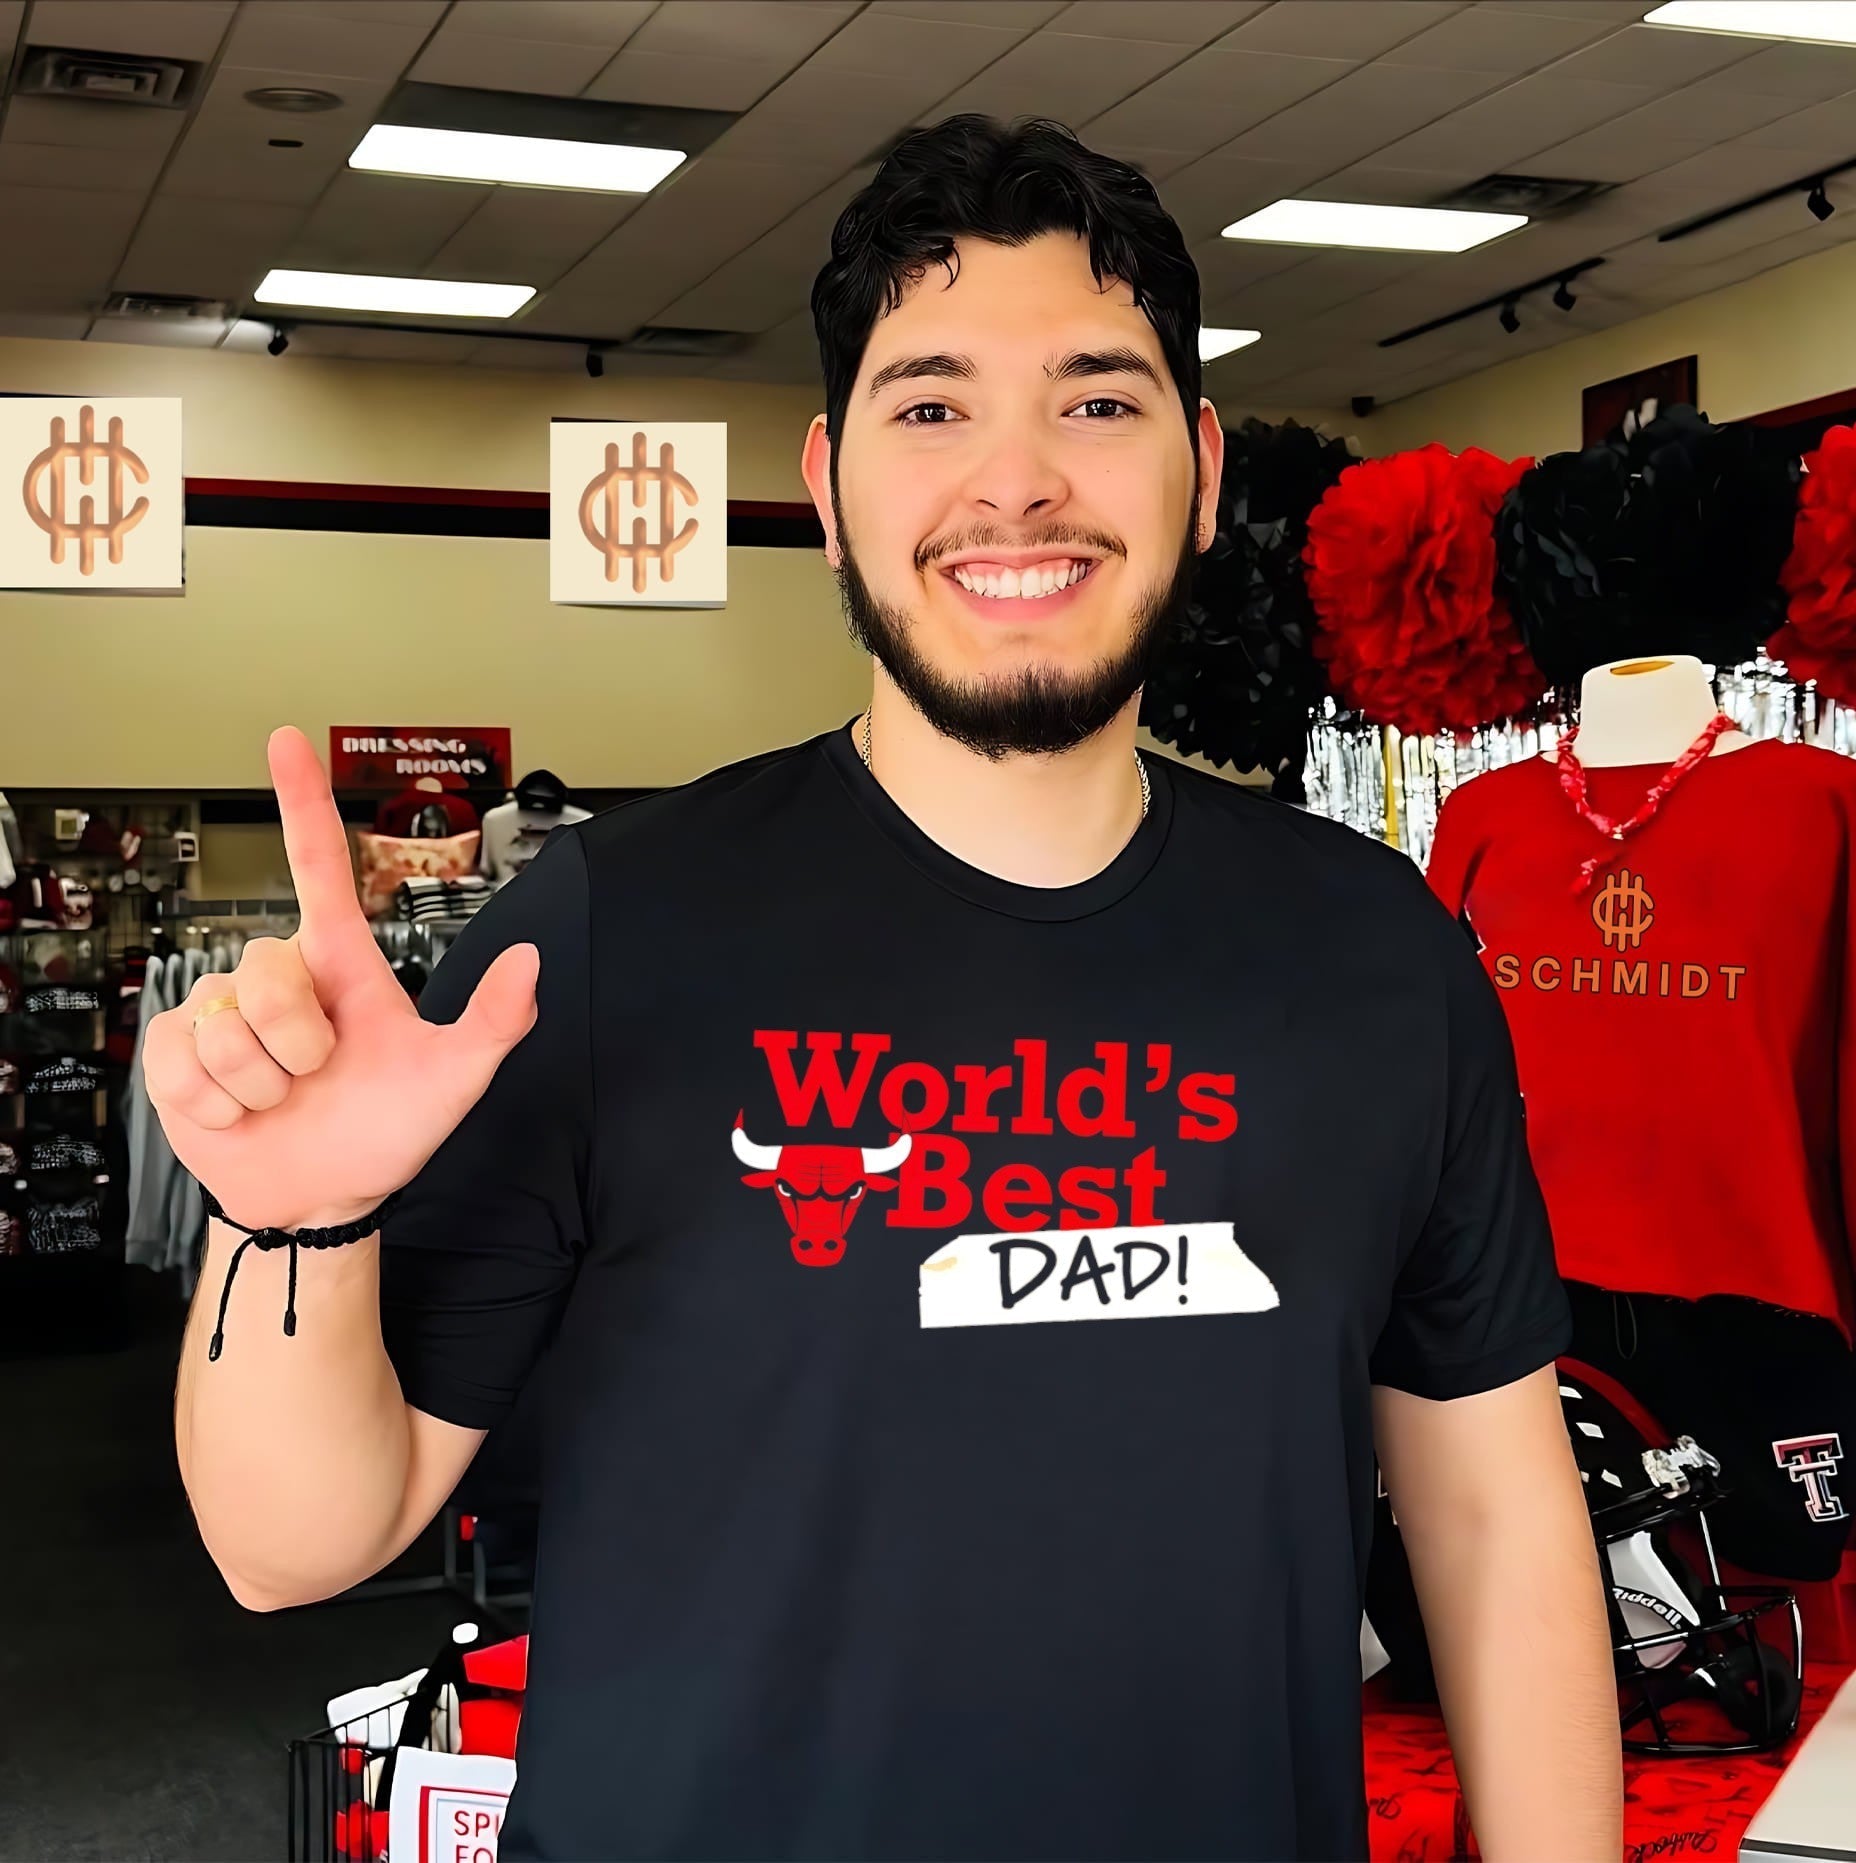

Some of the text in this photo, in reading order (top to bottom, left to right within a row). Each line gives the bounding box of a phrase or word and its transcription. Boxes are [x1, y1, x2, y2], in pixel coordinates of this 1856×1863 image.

[342, 737, 467, 753] DRESSING
[396, 758, 487, 775] ROOMS
[1494, 953, 1747, 1000] SCHMIDT
[753, 1029, 1239, 1143] World's
[886, 1131, 1167, 1233] Best
[989, 1234, 1189, 1310] DAD!
